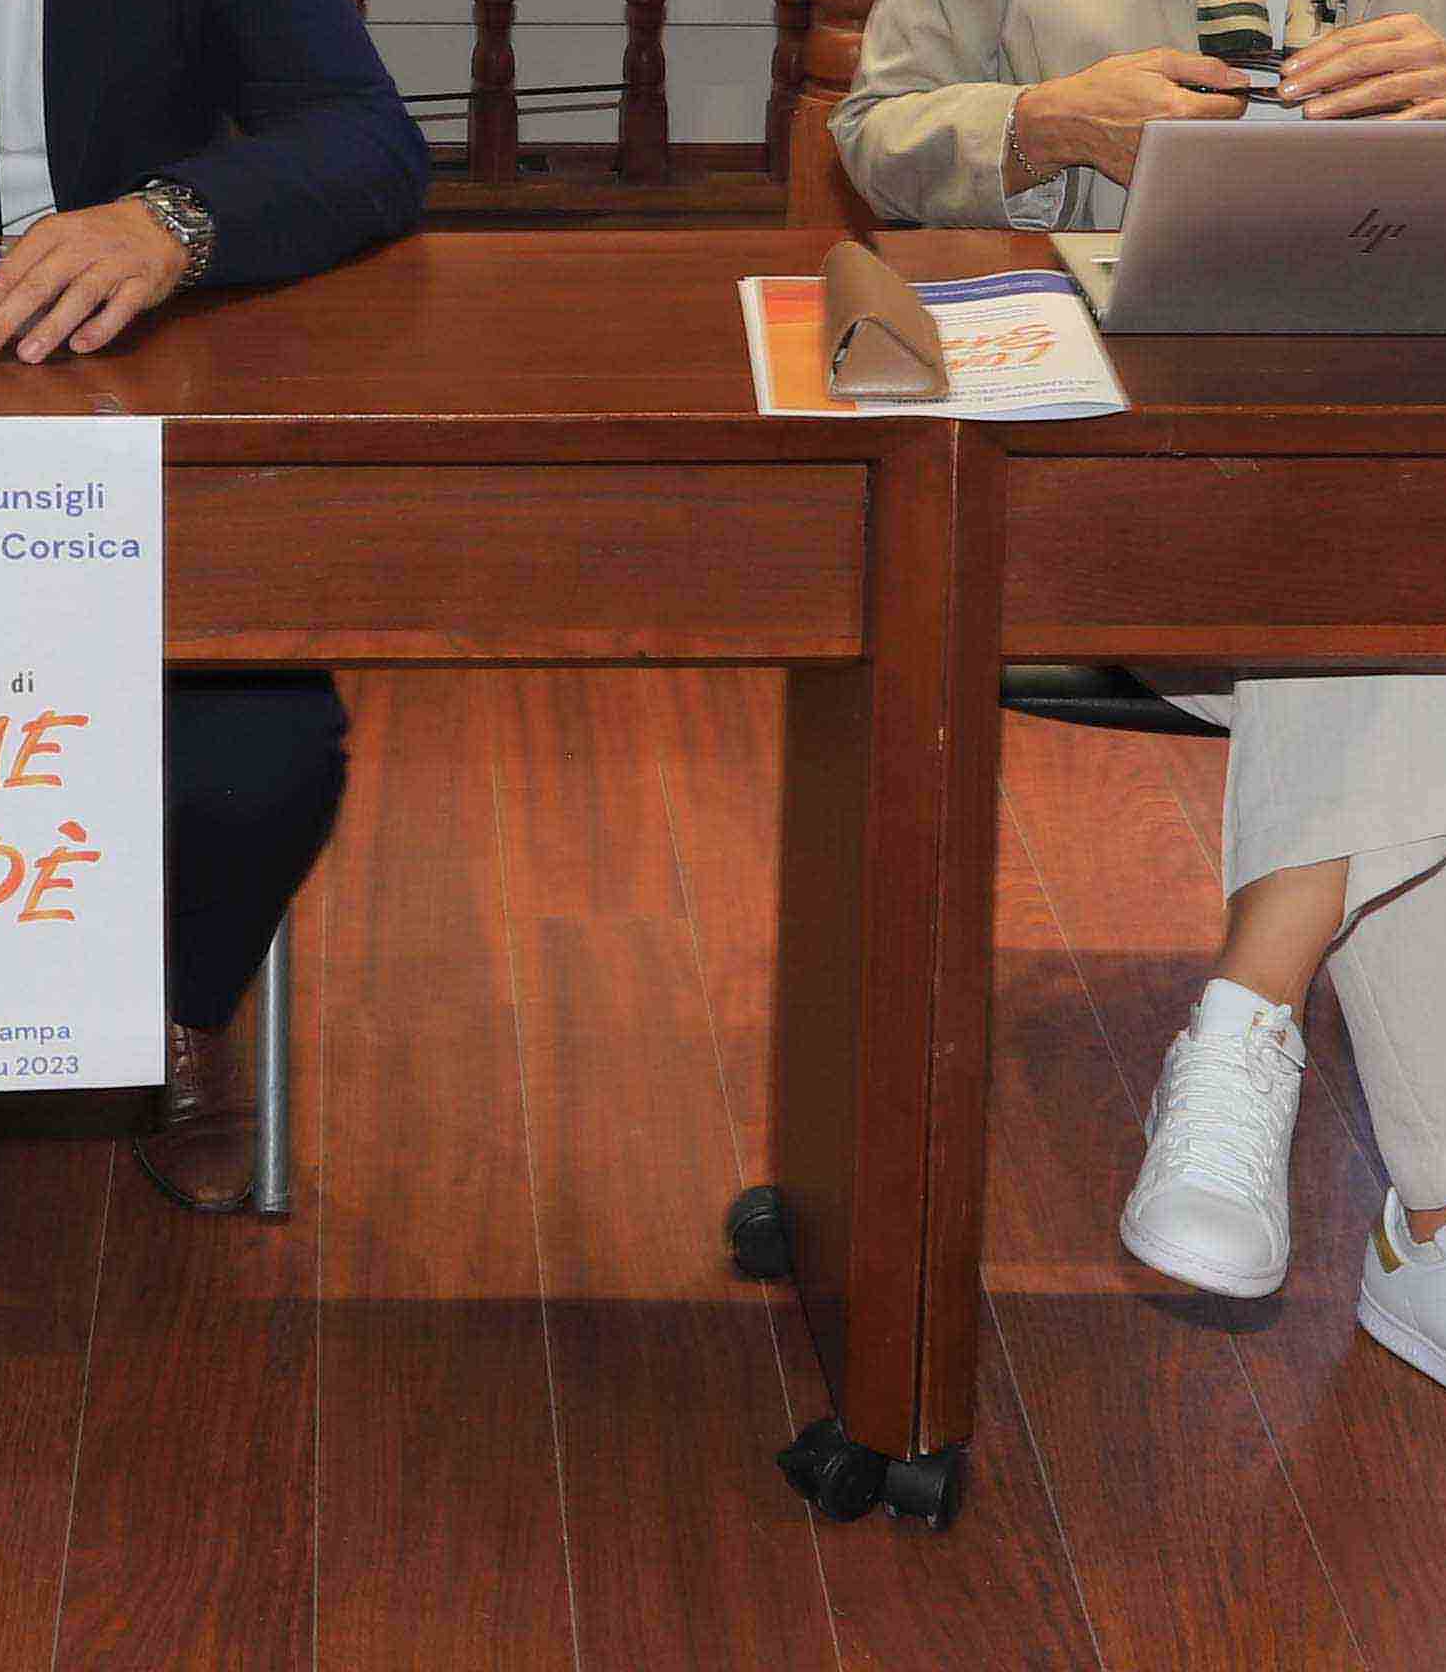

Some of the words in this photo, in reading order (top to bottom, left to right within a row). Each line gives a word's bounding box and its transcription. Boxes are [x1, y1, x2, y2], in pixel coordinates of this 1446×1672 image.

[1348, 209, 1407, 254] hp
[2, 533, 140, 559] Corsica
[12, 672, 33, 693] di
[14, 1056, 78, 1079] 2023
